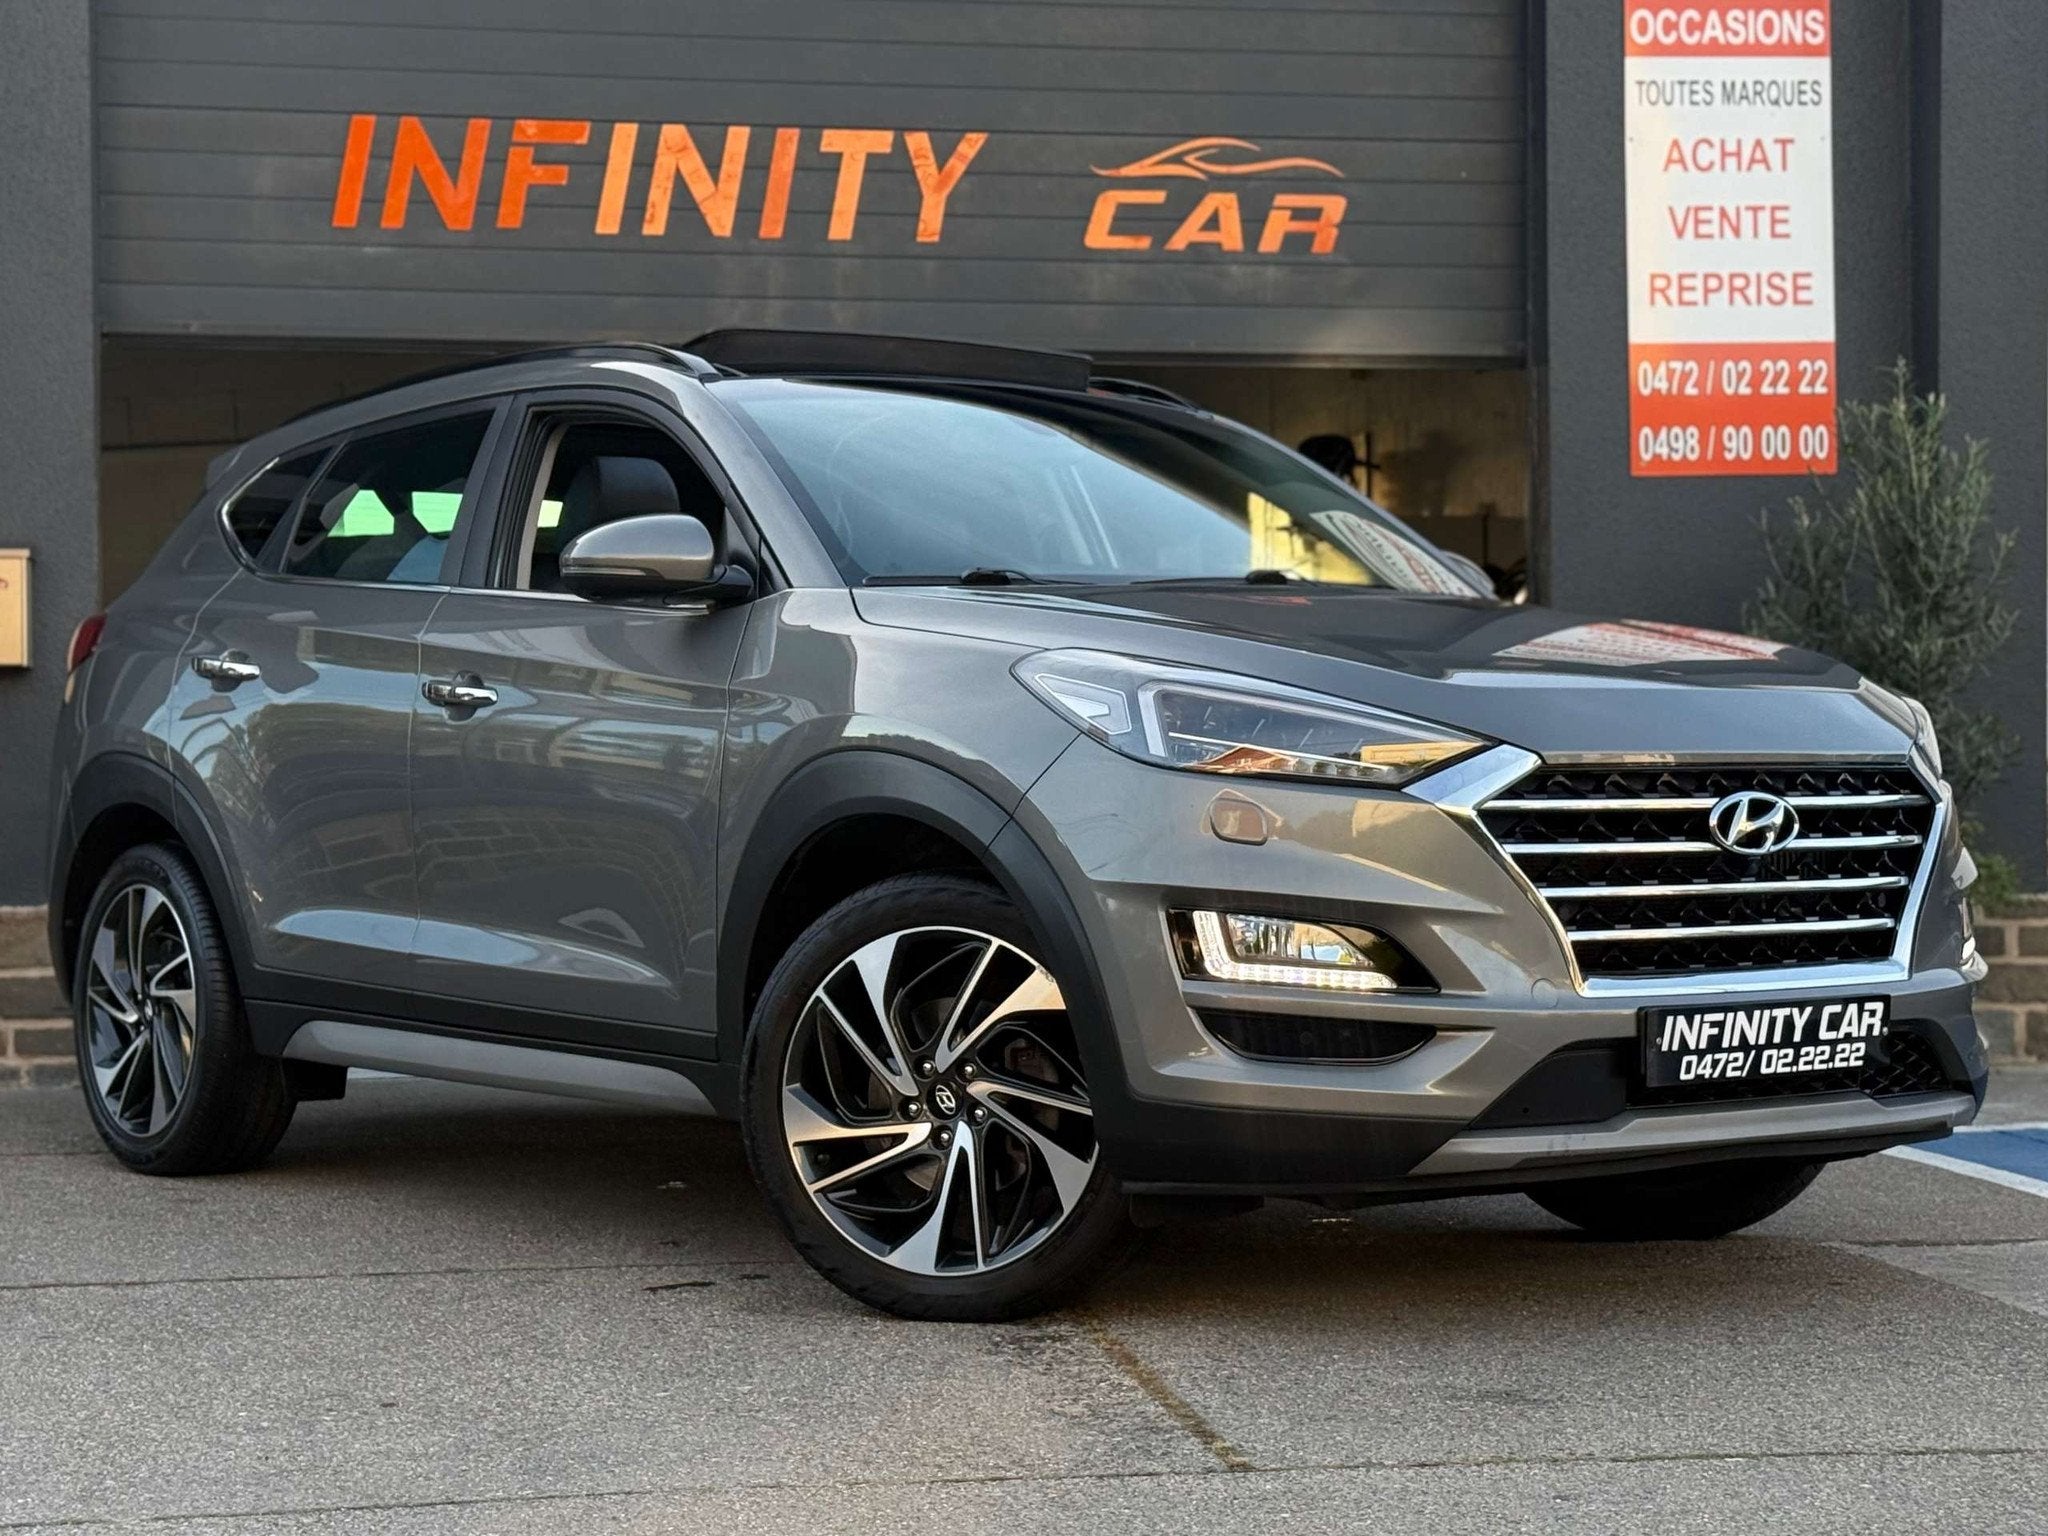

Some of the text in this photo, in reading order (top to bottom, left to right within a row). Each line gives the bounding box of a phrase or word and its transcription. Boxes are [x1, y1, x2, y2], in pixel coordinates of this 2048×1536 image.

[1629, 8, 1825, 45] OCCASIONS
[1635, 80, 1822, 106] TOUTES MARQUES
[1663, 138, 1795, 172] ACHAT
[331, 114, 1348, 254] INFINITY CAR
[1668, 205, 1790, 239] VENTE
[1649, 271, 1814, 306] REPRISE
[1637, 360, 1699, 396] 0472
[1721, 360, 1752, 395] 02
[1759, 359, 1790, 395] 22
[1798, 359, 1828, 395] 22
[1638, 425, 1700, 462] 0498
[1722, 424, 1753, 461] 90
[1761, 424, 1792, 460] 00
[1799, 424, 1829, 460] 00
[1661, 1001, 1885, 1052] INFINITY CAR
[1679, 1042, 1866, 1081] 0472/ 02.22.22
